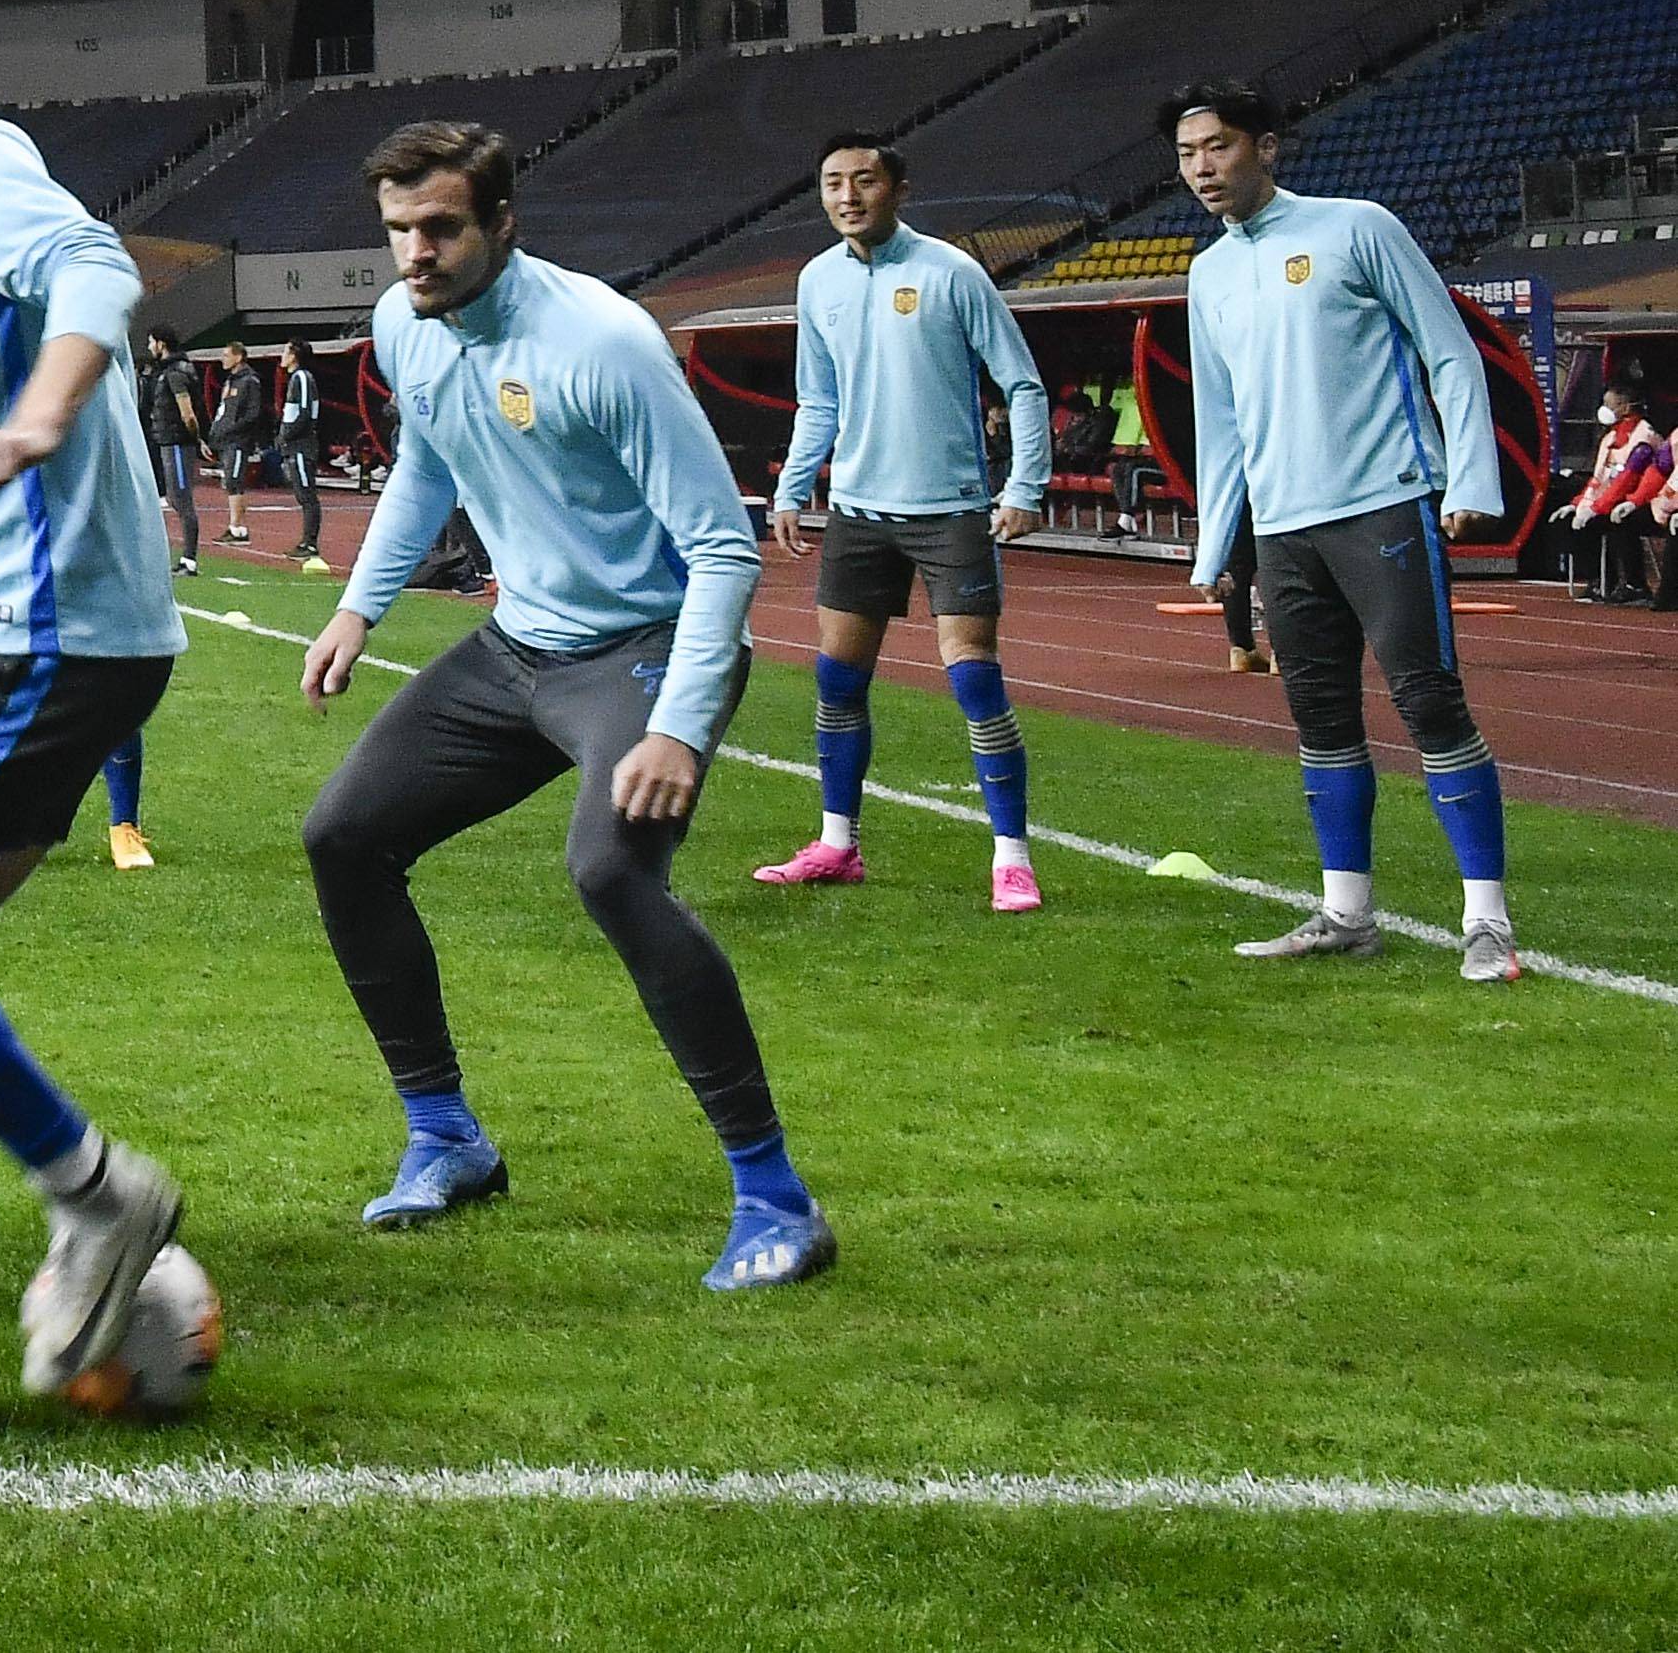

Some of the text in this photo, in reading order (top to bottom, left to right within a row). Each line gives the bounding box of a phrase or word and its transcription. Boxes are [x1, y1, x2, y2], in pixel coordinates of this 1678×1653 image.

[488, 3, 514, 20] 104
[74, 37, 99, 53] 105
[343, 266, 375, 288] 出口
